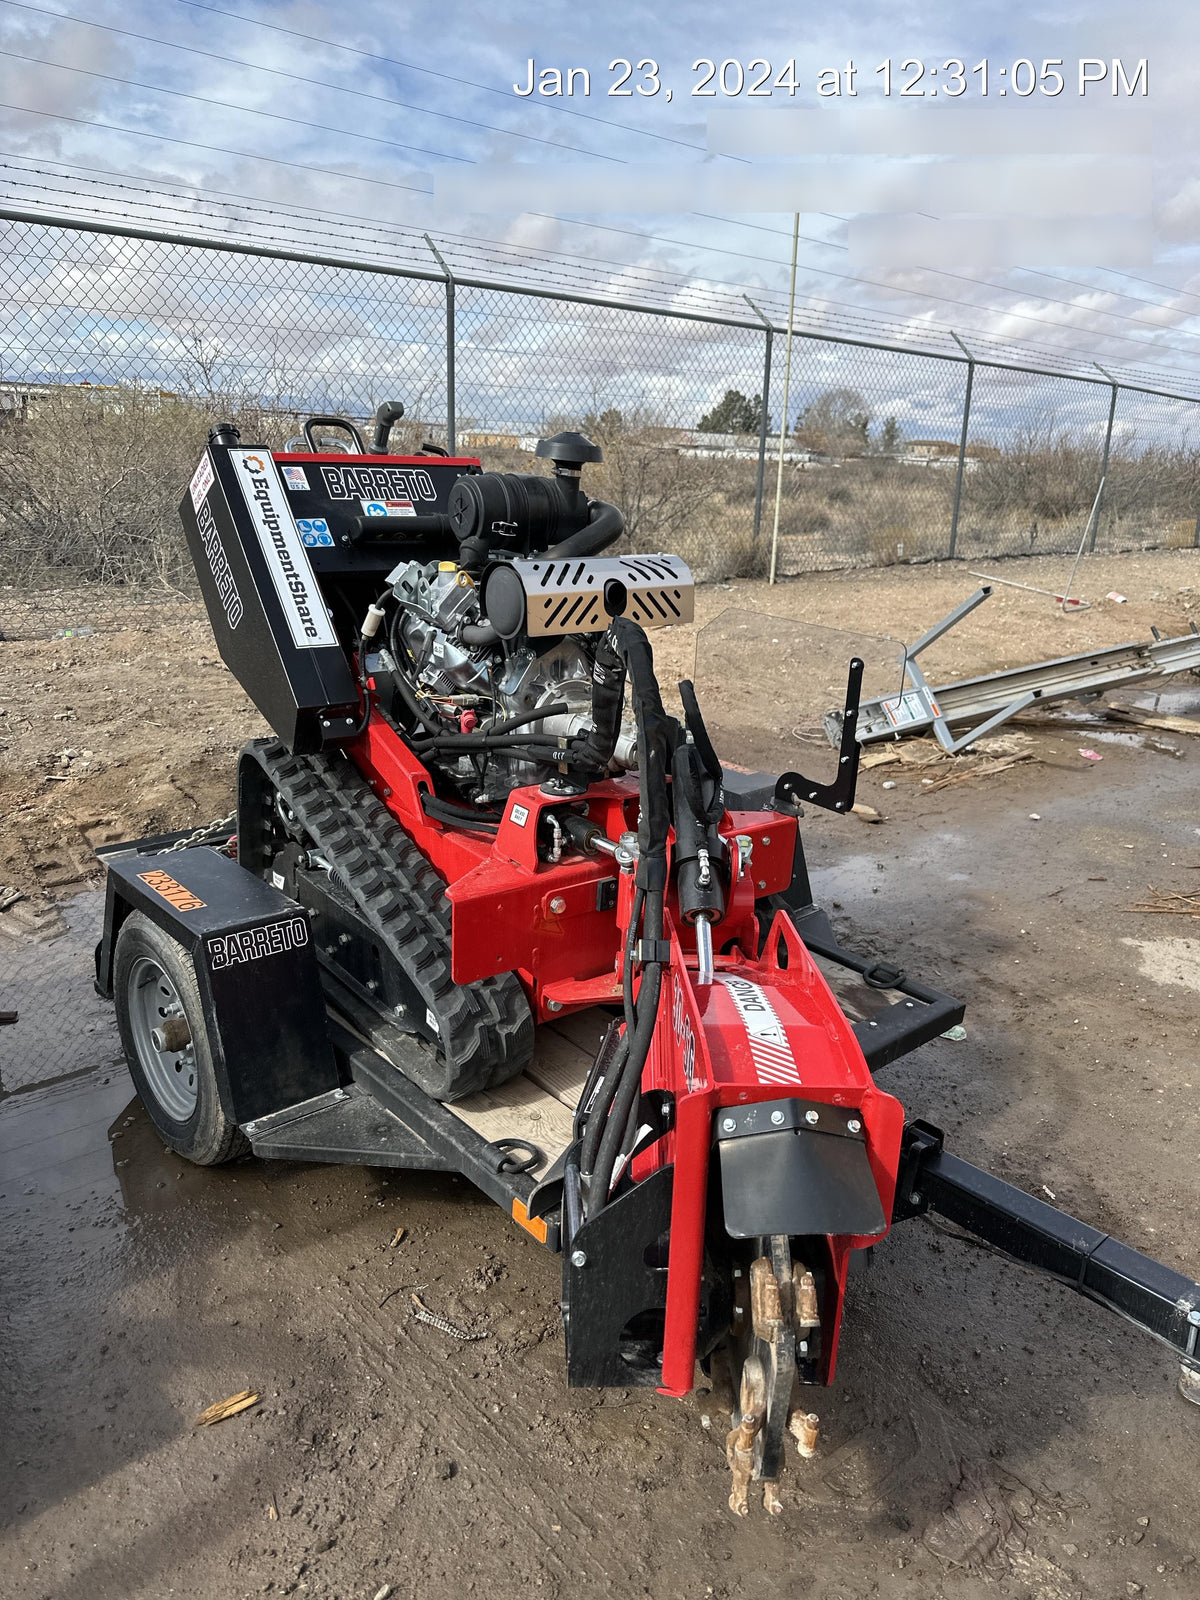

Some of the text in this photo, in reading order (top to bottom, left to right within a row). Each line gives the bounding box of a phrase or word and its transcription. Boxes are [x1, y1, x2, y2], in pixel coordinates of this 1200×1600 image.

[320, 466, 438, 502] BARRETO
[196, 497, 244, 631] BARRETO
[252, 477, 318, 639] EquipmentShare
[139, 871, 204, 911] 233176
[207, 917, 309, 971] BARRETO
[726, 980, 766, 1012] DANG
